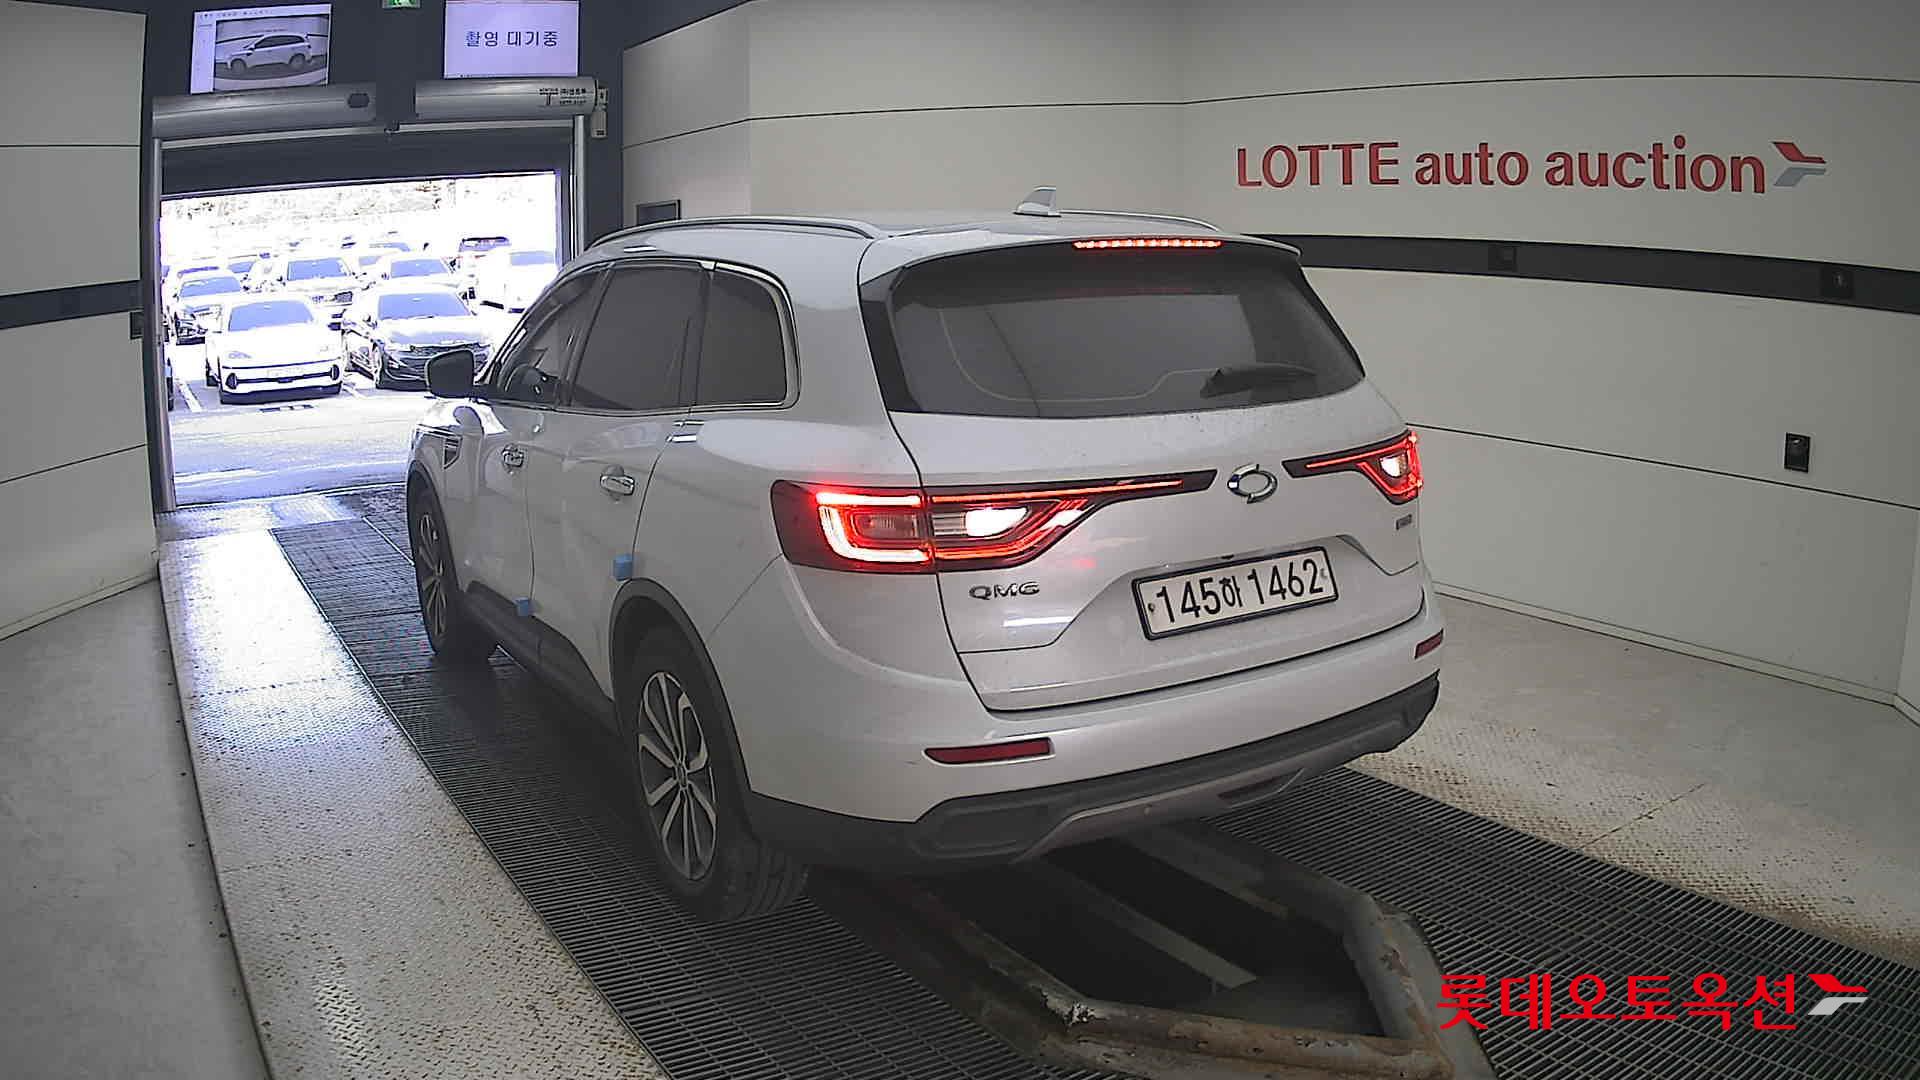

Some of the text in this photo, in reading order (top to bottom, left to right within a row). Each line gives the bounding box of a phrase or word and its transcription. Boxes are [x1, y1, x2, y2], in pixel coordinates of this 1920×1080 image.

[507, 31, 558, 47] 대기중
[1237, 135, 1765, 194] LOTTE auto auction
[969, 581, 1040, 600] QM6
[1247, 558, 1324, 605] 1462
